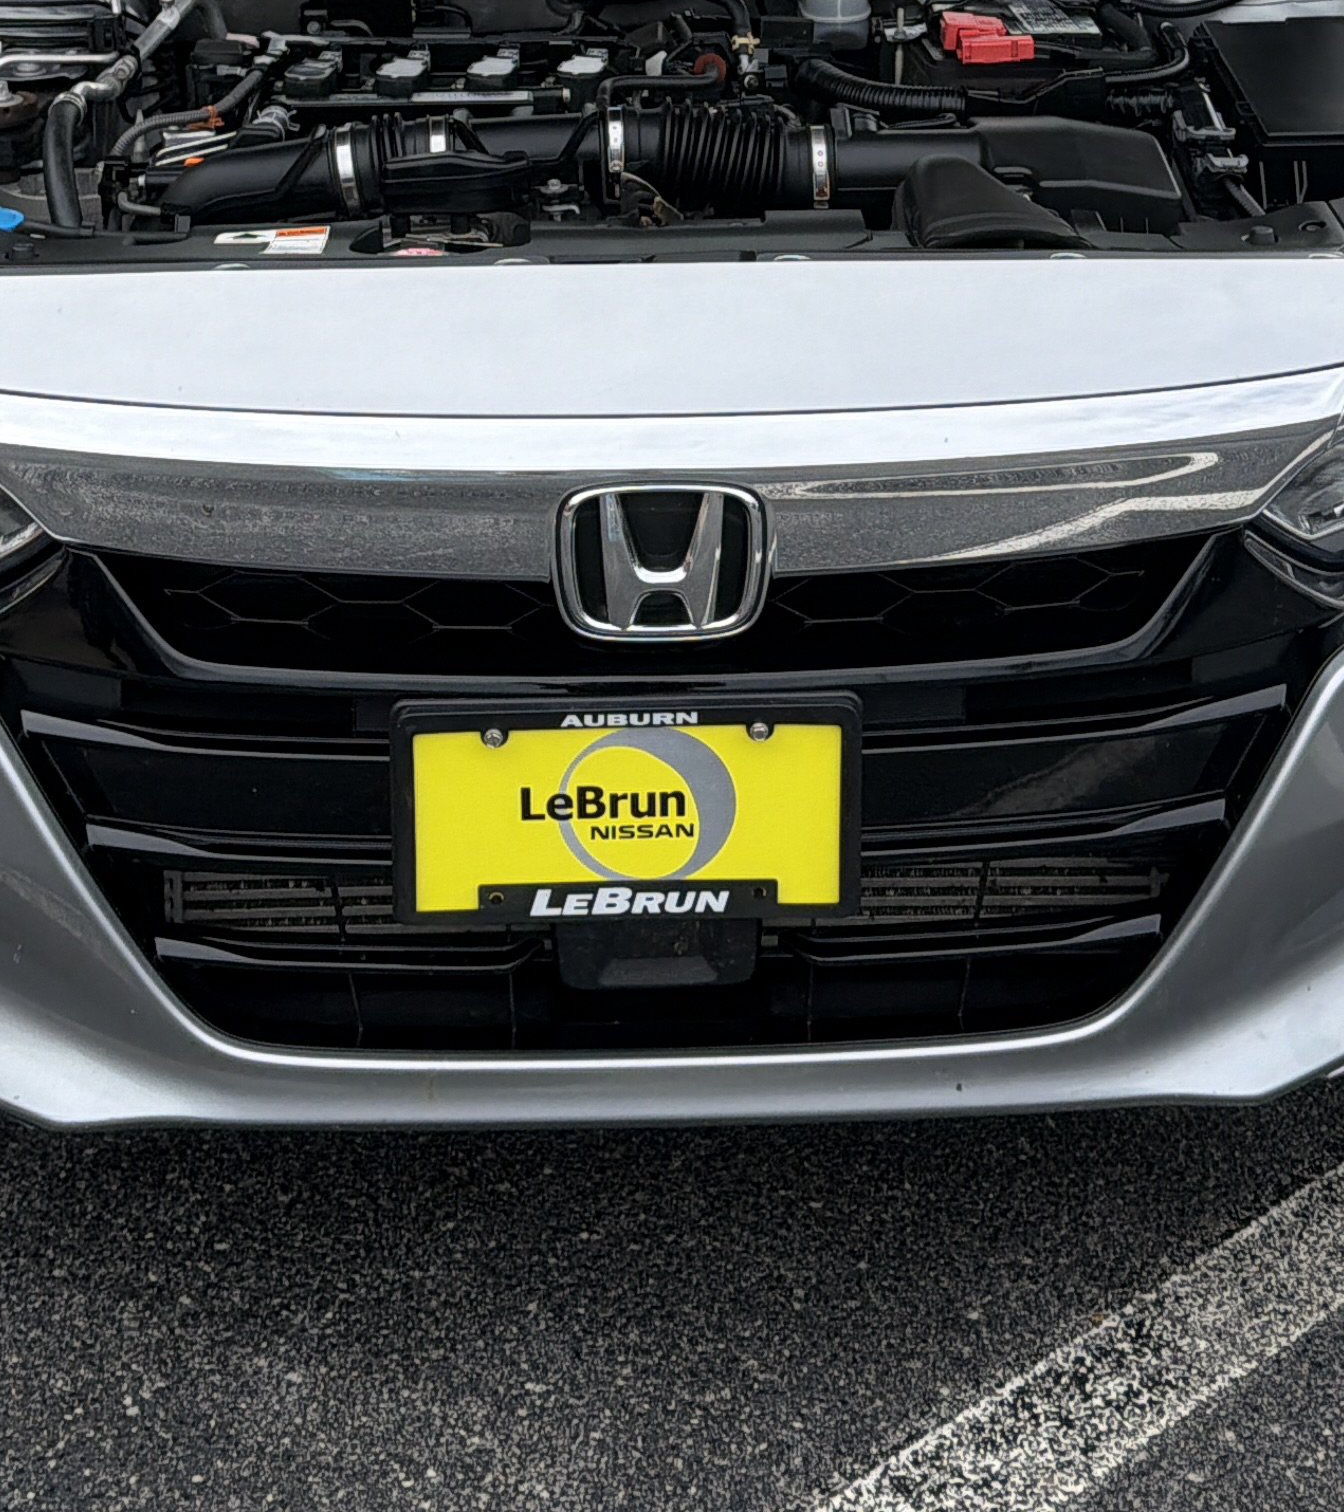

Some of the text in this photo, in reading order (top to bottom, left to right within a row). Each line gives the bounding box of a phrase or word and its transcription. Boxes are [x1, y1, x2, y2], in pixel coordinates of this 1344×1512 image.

[560, 711, 698, 728] AUBURN
[520, 785, 686, 821] LeBrun
[590, 823, 695, 840] NISSAN
